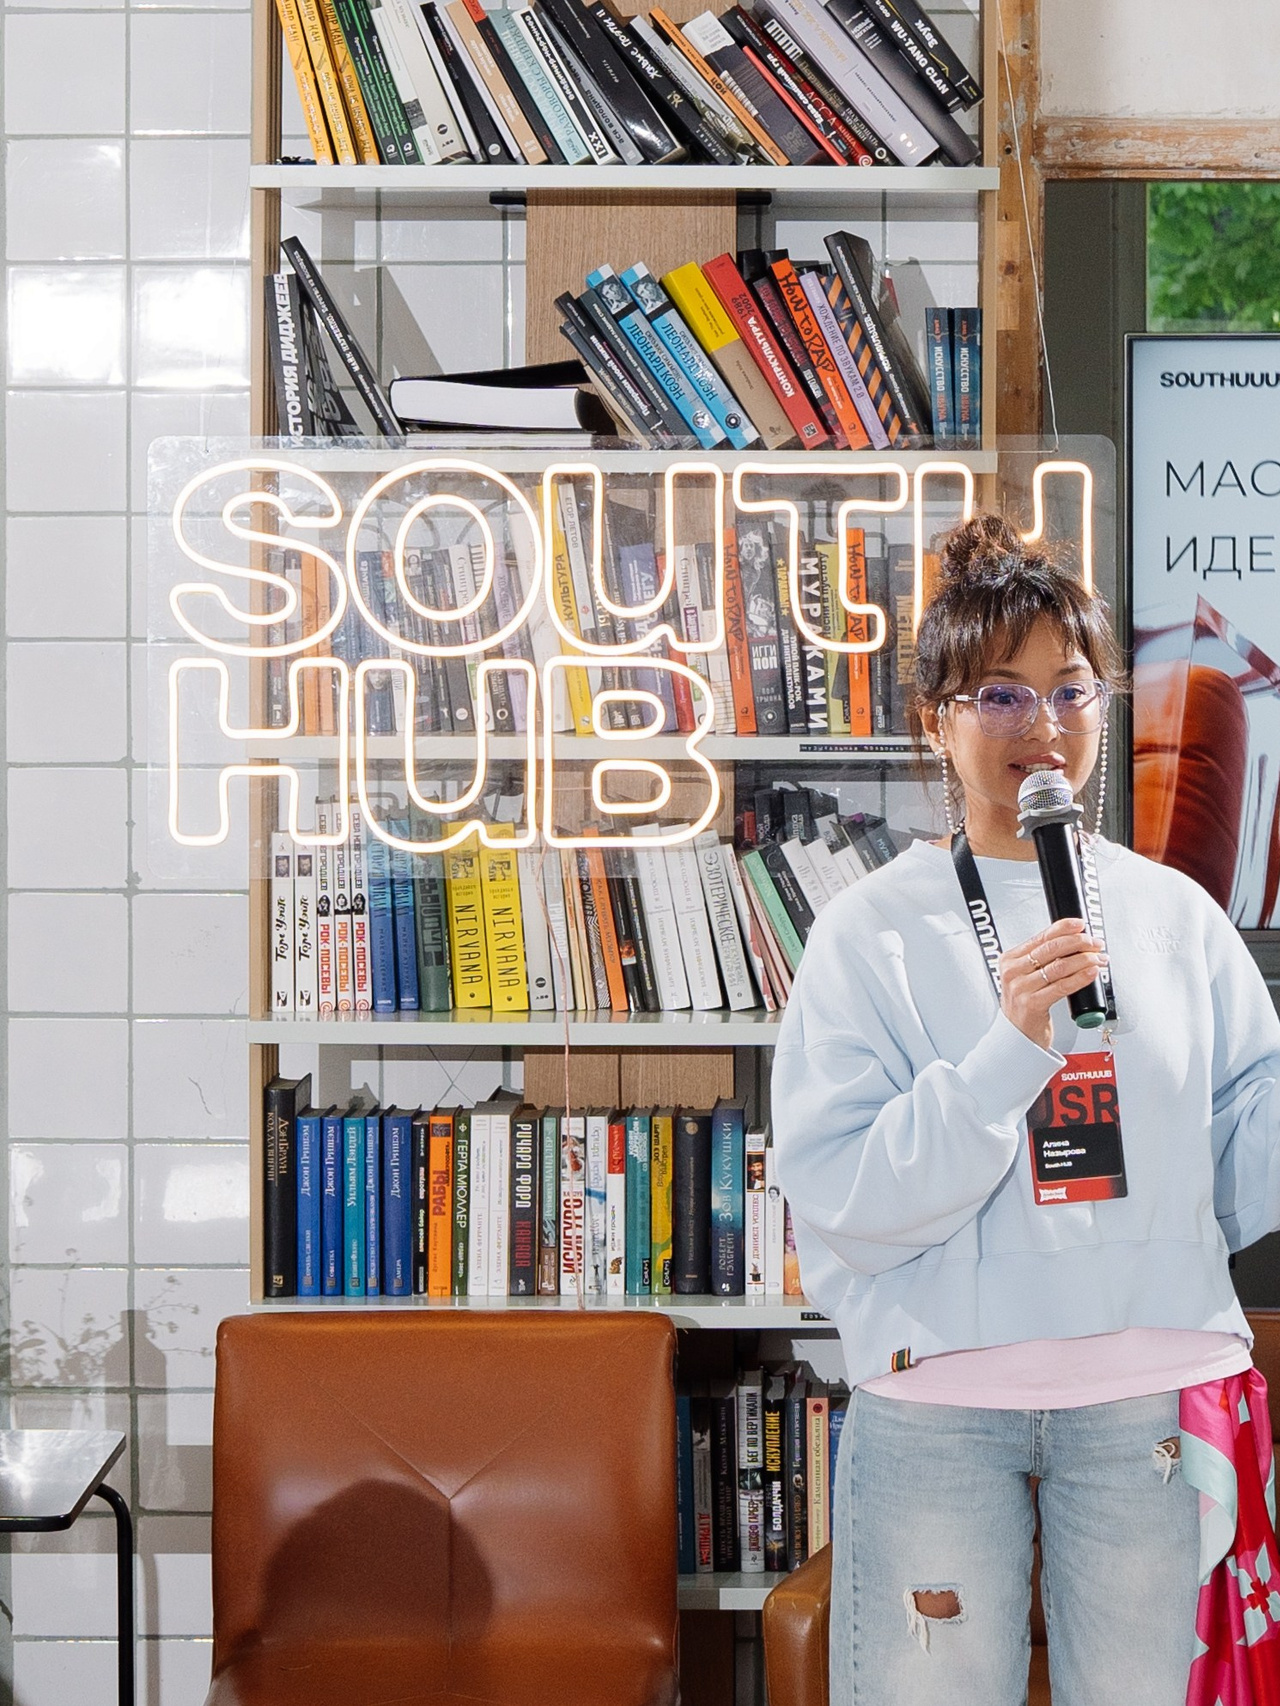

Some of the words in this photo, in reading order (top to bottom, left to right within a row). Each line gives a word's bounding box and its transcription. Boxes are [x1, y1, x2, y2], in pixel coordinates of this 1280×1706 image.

[330, 27, 343, 45] КАН
[501, 11, 536, 67] КЕЙДЖЕМ
[531, 66, 541, 76] С
[765, 51, 780, 68] гул
[889, 19, 930, 67] WU-TANG
[924, 65, 950, 94] CLAN
[538, 75, 575, 136] РАЗГОВОРЫ
[775, 65, 810, 106] слышный
[583, 87, 614, 130] володина
[360, 137, 372, 154] JAZZ
[273, 273, 299, 363] ДИДЖЕЕВ
[730, 295, 747, 319] 1989
[737, 291, 755, 314] 2002
[816, 302, 841, 345] ХОЖДЕНИЕ
[589, 333, 611, 361] жизни
[626, 321, 666, 373] ЛЕОНАРД
[659, 369, 685, 400] КОЭН
[660, 321, 700, 373] ЛЕОНАРД
[803, 332, 837, 377] RAP
[835, 344, 846, 356] ПО
[607, 358, 625, 380] моей
[840, 355, 859, 386] ЗВУКАМ
[935, 346, 944, 390] ИСКУССТВО
[960, 347, 969, 392] ИСКУССТВО
[621, 377, 651, 416] Призраки
[853, 385, 865, 399] 2.0
[569, 521, 578, 548] ЛЕТОВ
[818, 552, 830, 594] пустоту
[725, 603, 745, 642] RAP
[781, 628, 789, 642] ДЛЯ
[751, 644, 775, 657] ИГГИ
[752, 656, 777, 670] ПОП
[789, 635, 798, 659] ТУПОЙ
[783, 643, 795, 709] ИНТЕЛЛЕКТУАЛОВ
[791, 661, 802, 701] ПАНК-РОК
[167, 654, 722, 853] HUB
[354, 836, 362, 889] НОВГОРОДЦЕВ
[320, 924, 330, 994] РОК-ПОСЕВЫ
[338, 922, 348, 992] РОК-ПОСЕВЫ
[356, 922, 366, 992] РОК-ПОСЕВЫ
[455, 904, 482, 985] NIRVANA
[493, 906, 519, 989] NIRVANA
[1061, 1070, 1113, 1082] SOUTHUUUB
[347, 1127, 356, 1166] Лэндей
[458, 1139, 467, 1169] ГЕРТА
[516, 1123, 532, 1169] РИЧАРД
[1043, 1140, 1070, 1149] Алина
[1043, 1147, 1087, 1158] Назырова
[347, 1167, 356, 1207] Уильям
[433, 1170, 446, 1215] РАБЫ
[457, 1173, 466, 1227] МЮЛЛЕР
[516, 1174, 532, 1208] ФОРД
[515, 1221, 530, 1267] КАНАДА
[561, 1198, 582, 1273] ИСИГУРО
[752, 1226, 760, 1259] ДЭНИЕЛ
[745, 1392, 758, 1435] ВЕРТИКАЛИ
[746, 1437, 757, 1446] ПО
[746, 1450, 758, 1462] БЕГ
[765, 1410, 781, 1471] ИСКУПЛЕНИЕ
[812, 1417, 821, 1456] обезьяна
[813, 1459, 821, 1504] Каменная
[747, 1500, 759, 1523] ГАРБЕР
[771, 1480, 782, 1530] БОЛДАЧЧИ
[748, 1524, 760, 1551] ДЖОЗЕФ
